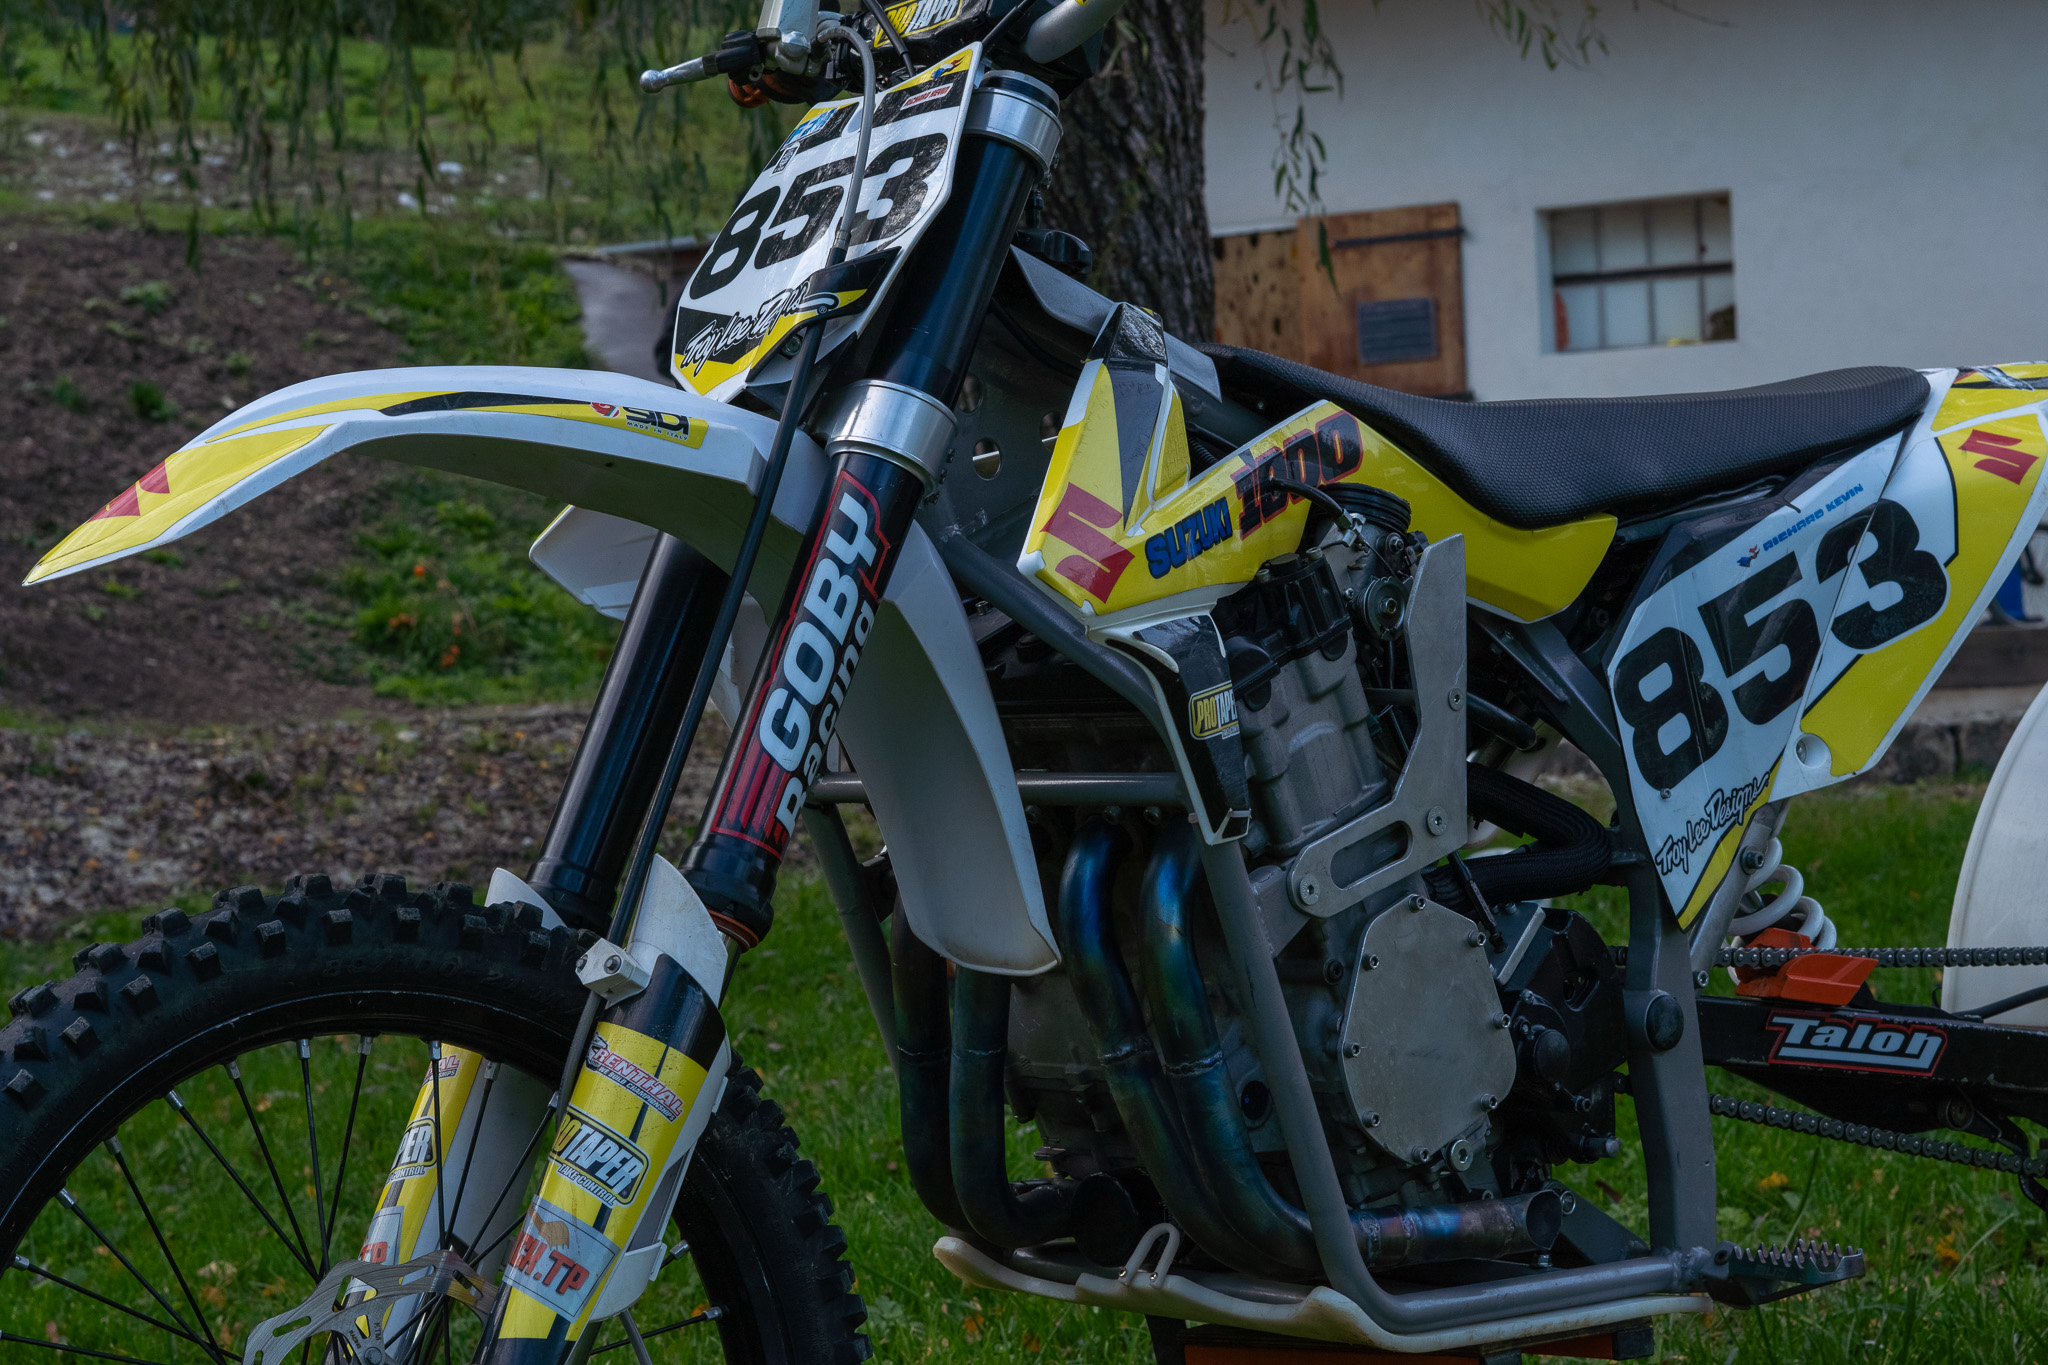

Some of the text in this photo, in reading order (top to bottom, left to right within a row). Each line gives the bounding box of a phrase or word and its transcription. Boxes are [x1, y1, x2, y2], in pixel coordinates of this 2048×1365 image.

[689, 132, 948, 300] 853
[626, 421, 649, 430] MADE
[667, 431, 689, 441] ITALY
[1230, 410, 1364, 540] 1000
[1144, 497, 1233, 579] SUZUKI
[1762, 483, 1864, 551] RICHARD KEVIN
[759, 491, 877, 772] GOBY
[1614, 498, 1947, 791] 853
[1195, 689, 1237, 732] PROTAPE
[1655, 771, 1770, 876] Troy Lee Designs
[1771, 1015, 1943, 1069] Talon
[592, 1047, 684, 1117] RENTHAL
[608, 1071, 627, 1085] BUILD
[626, 1082, 676, 1121] CHAMPIONSHIPS
[559, 1164, 617, 1206] TAKE CONTROL
